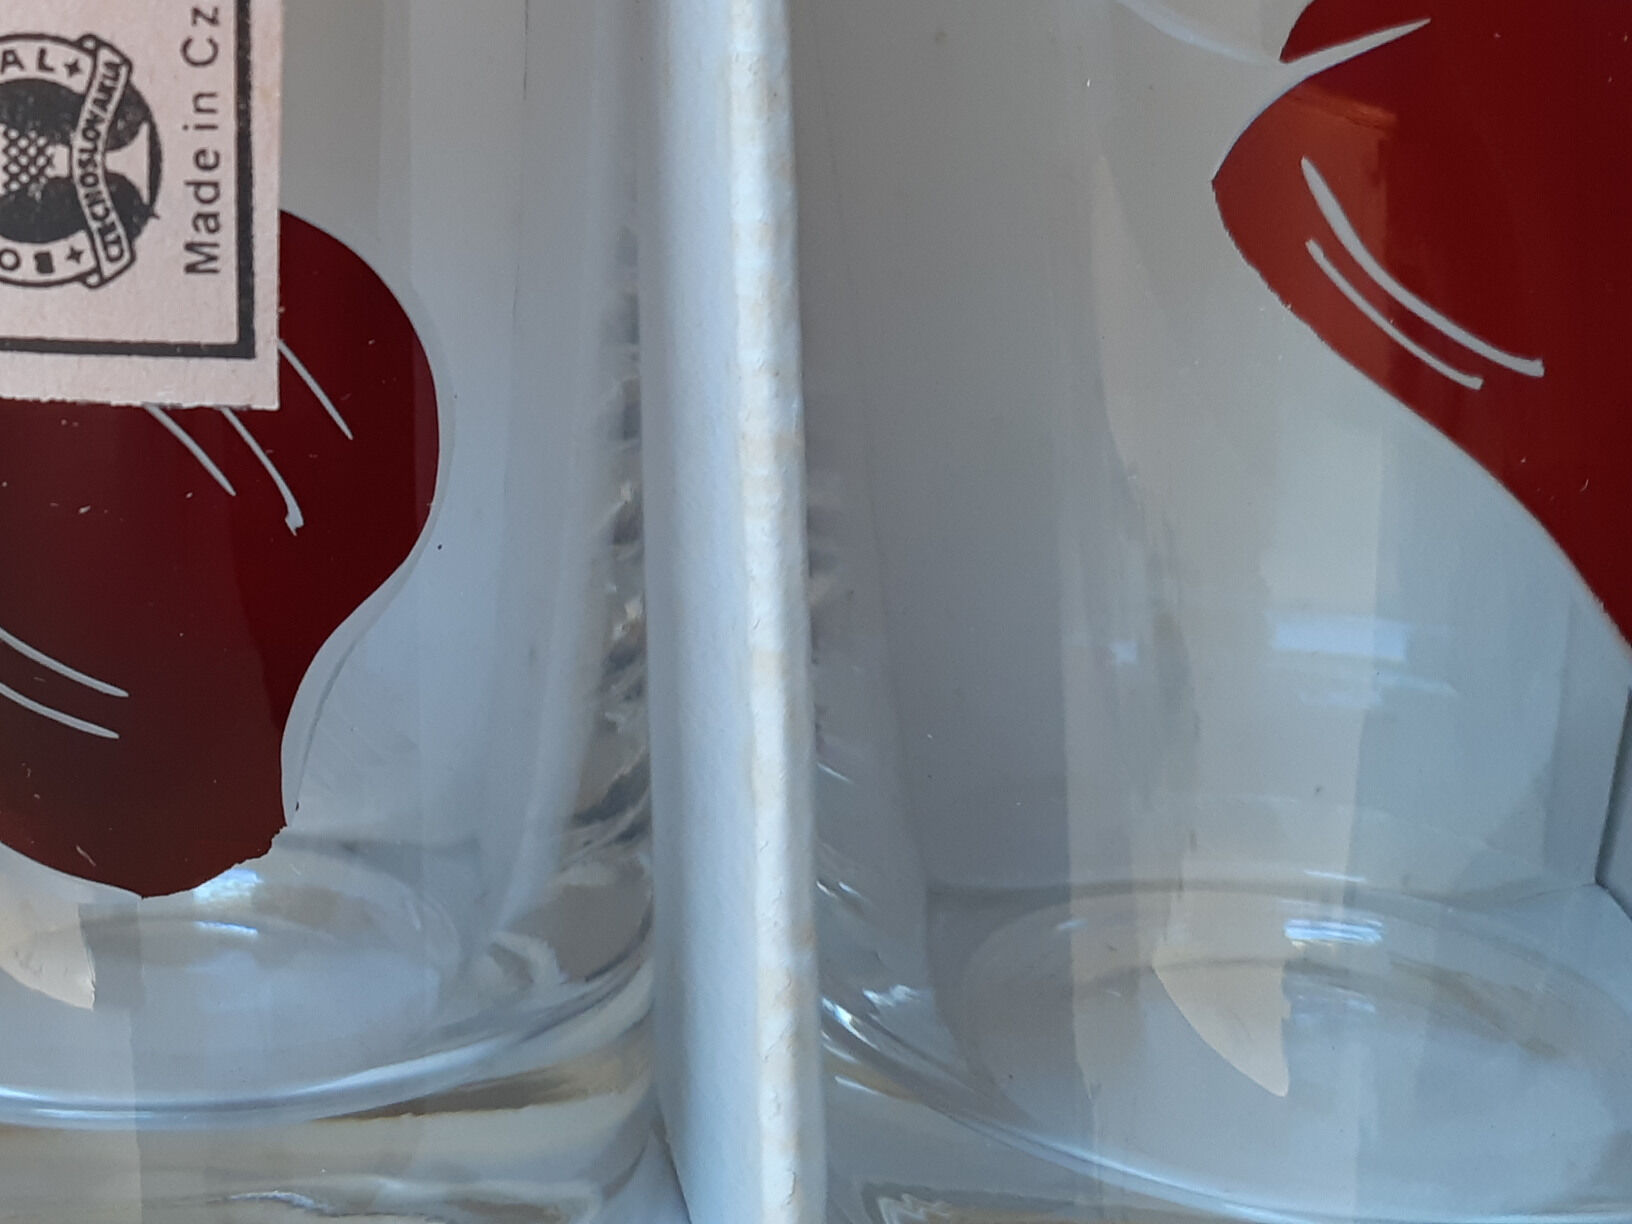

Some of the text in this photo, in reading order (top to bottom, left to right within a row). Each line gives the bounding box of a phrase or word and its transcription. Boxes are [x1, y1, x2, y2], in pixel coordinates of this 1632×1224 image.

[77, 60, 126, 264] CZECHOSLOVAKIA
[182, 90, 220, 131] in
[182, 147, 222, 275] Made
